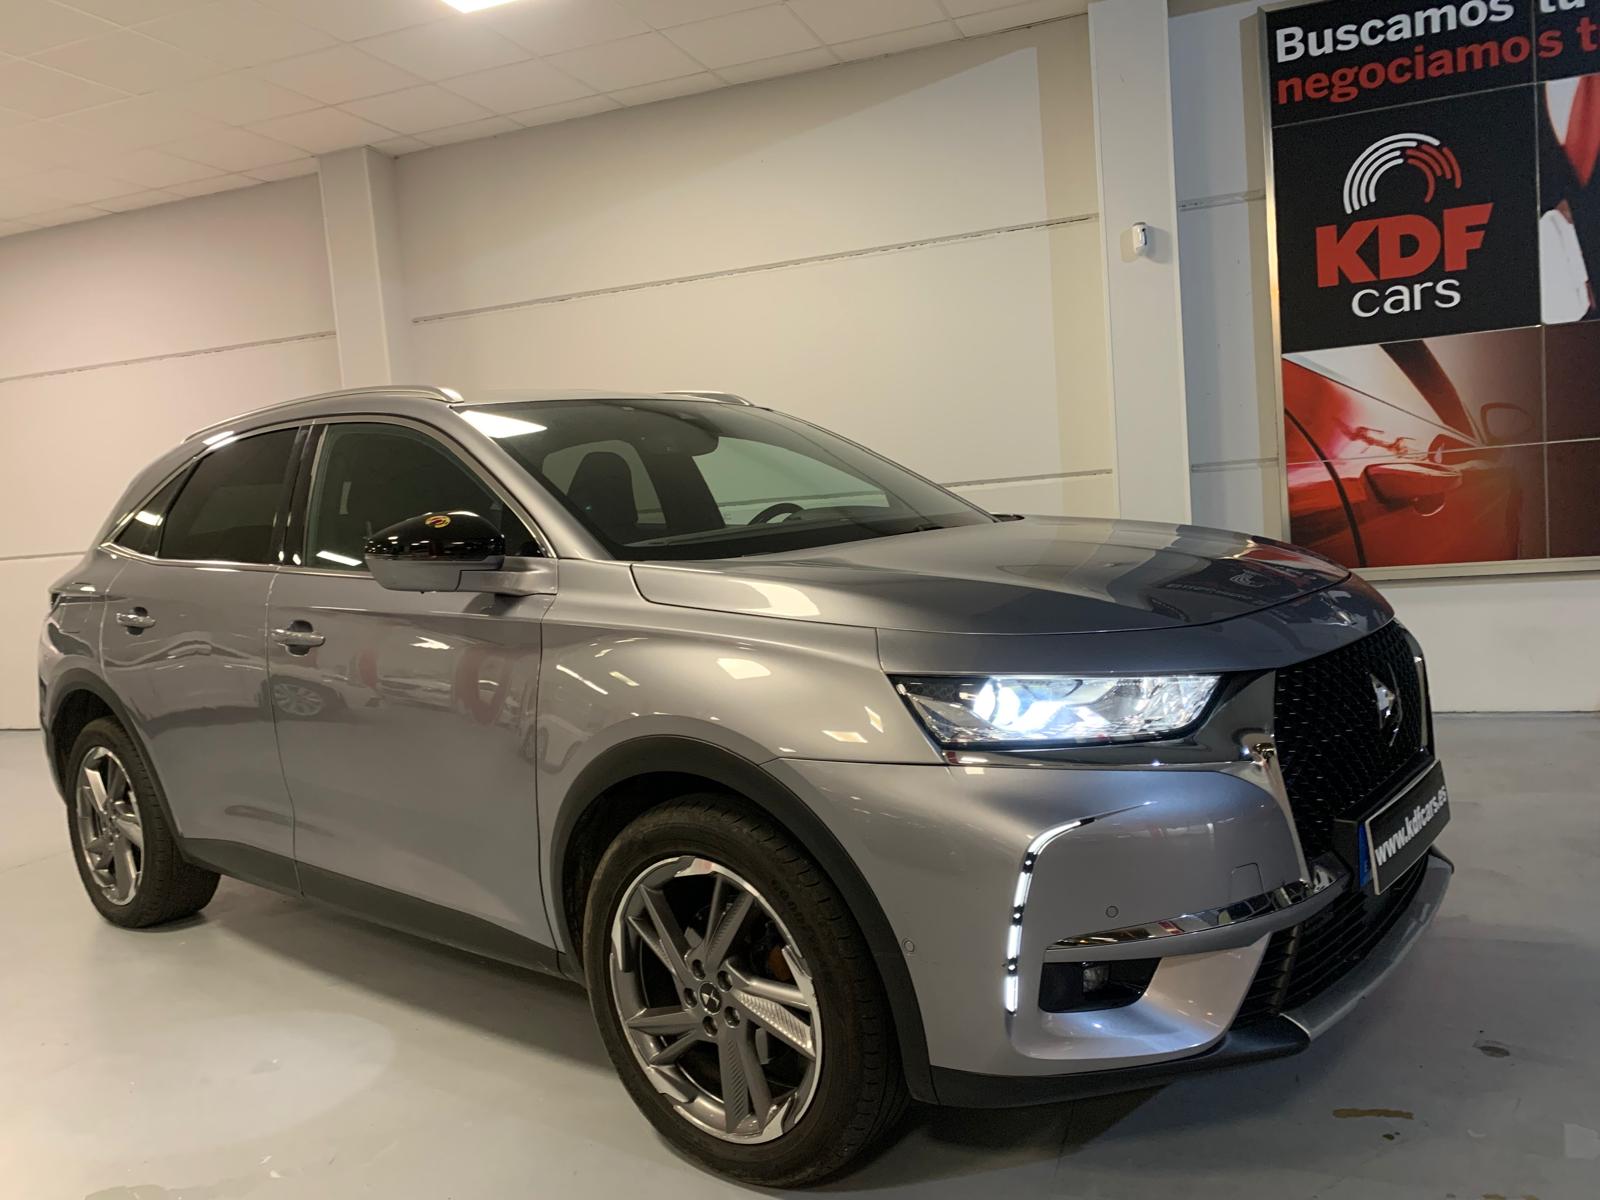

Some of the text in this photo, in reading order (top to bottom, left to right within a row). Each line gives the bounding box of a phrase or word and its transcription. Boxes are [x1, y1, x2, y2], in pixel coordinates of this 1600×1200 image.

[1276, 0, 1514, 63] Buscamos
[1277, 17, 1600, 104] negociamos t
[1316, 202, 1494, 288] KDF
[1352, 279, 1461, 318] cars
[1374, 785, 1447, 867] www.kdfcars.es
